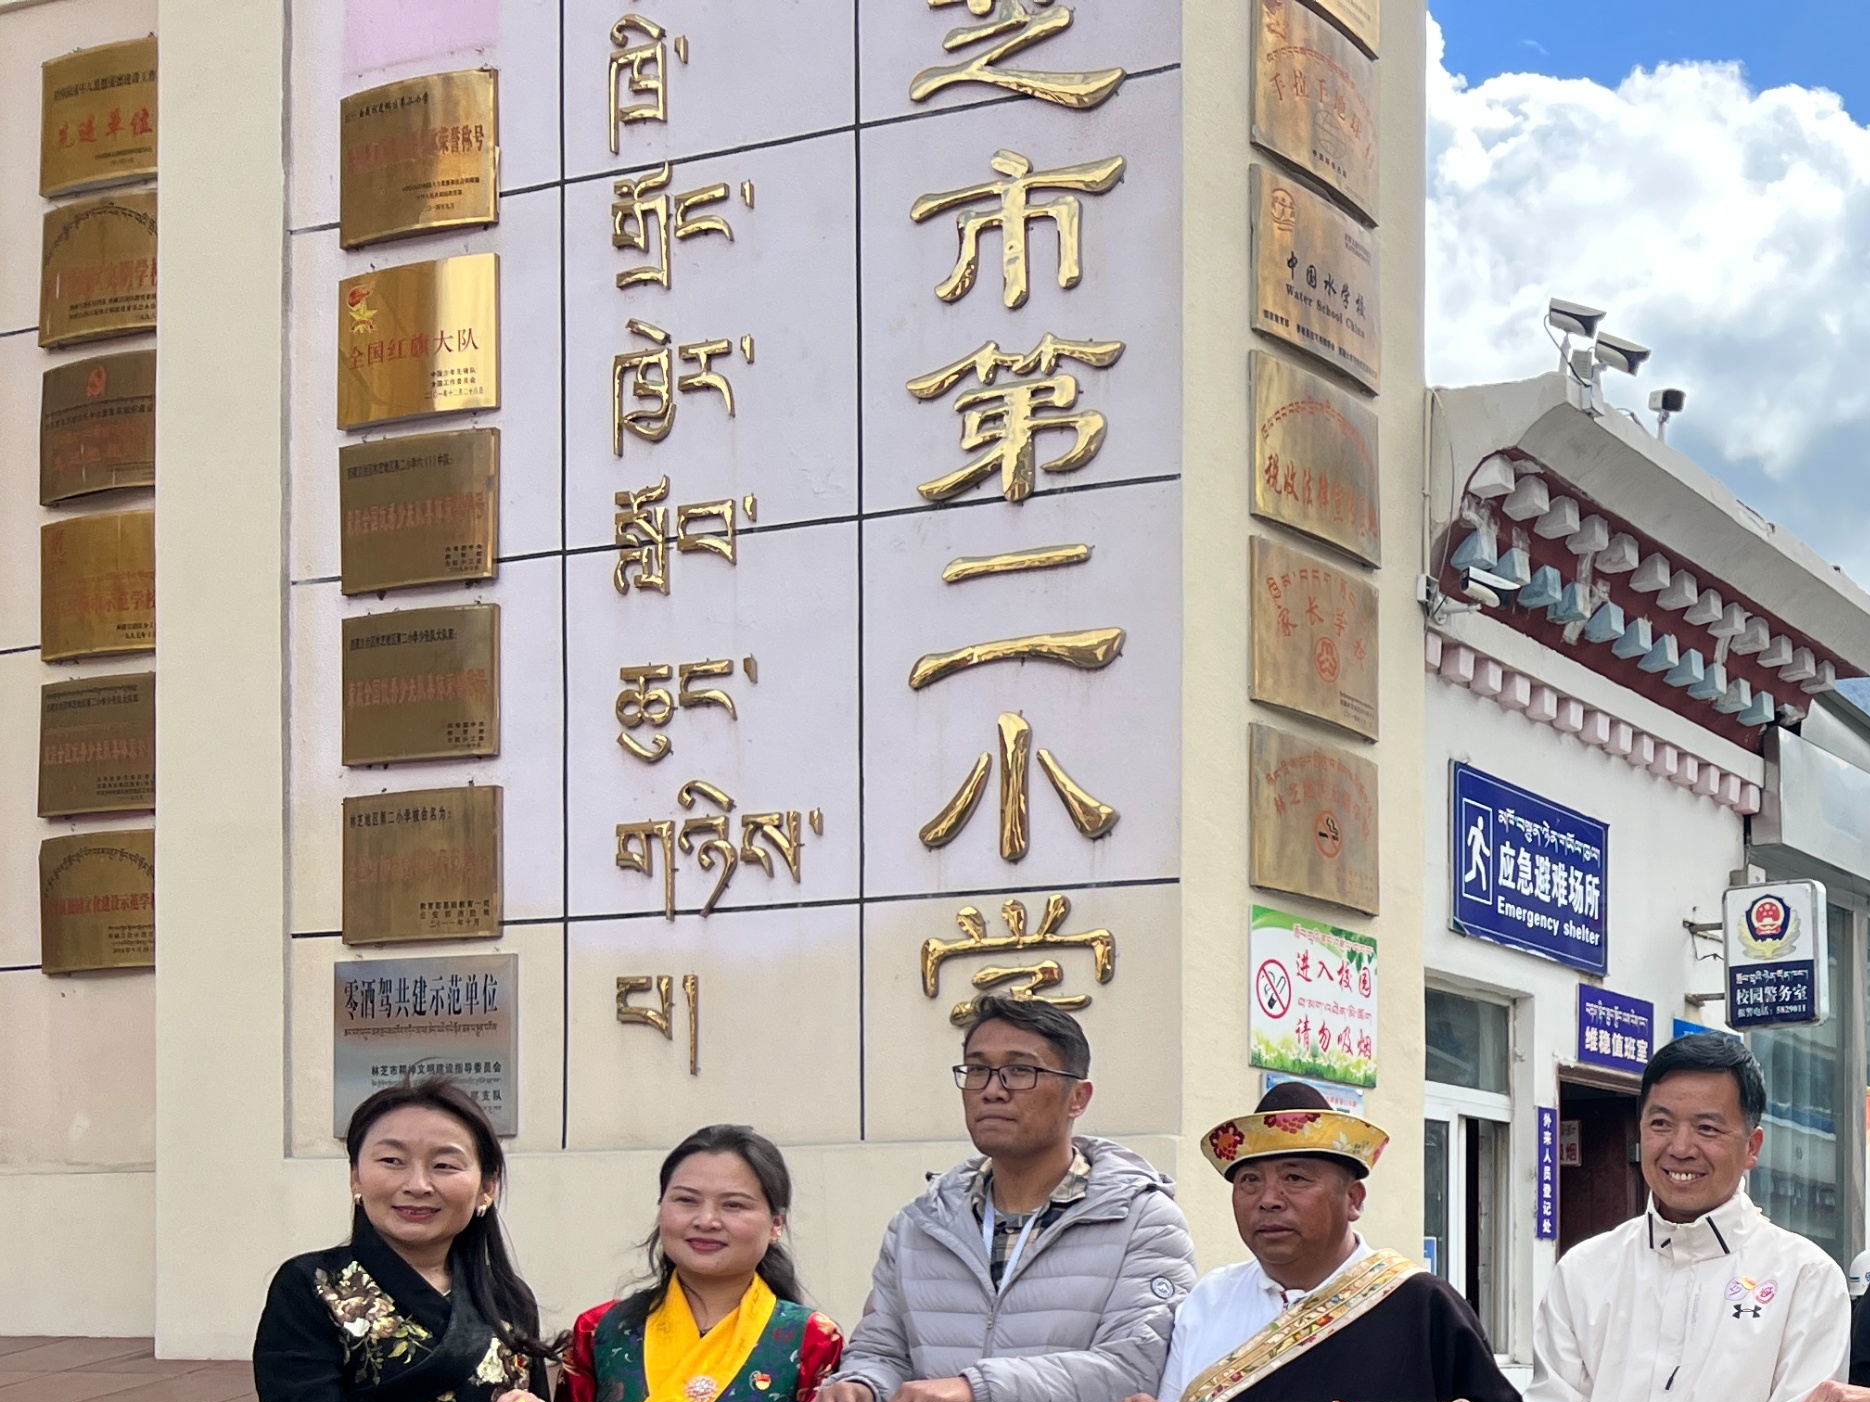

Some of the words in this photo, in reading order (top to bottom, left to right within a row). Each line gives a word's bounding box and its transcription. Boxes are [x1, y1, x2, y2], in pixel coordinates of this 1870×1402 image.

[59, 107, 153, 149] 先进单位
[1285, 283, 1313, 308] Water
[1316, 299, 1343, 326] School
[1286, 250, 1366, 320] 中国水学校
[349, 328, 479, 370] 全国红旗大队
[1499, 840, 1600, 920] 应急避难场所
[1498, 895, 1560, 936] Emergency
[1563, 920, 1600, 946] shelter
[344, 973, 498, 1020] 零酒驾共建示范单位
[1295, 950, 1372, 999] 进入校园
[1736, 983, 1808, 1005] 校园警务室
[1295, 1014, 1373, 1061] 请勿吸烟
[1585, 1025, 1649, 1064] 维稳值班室
[1542, 1112, 1553, 1234] 外来人员登记处
